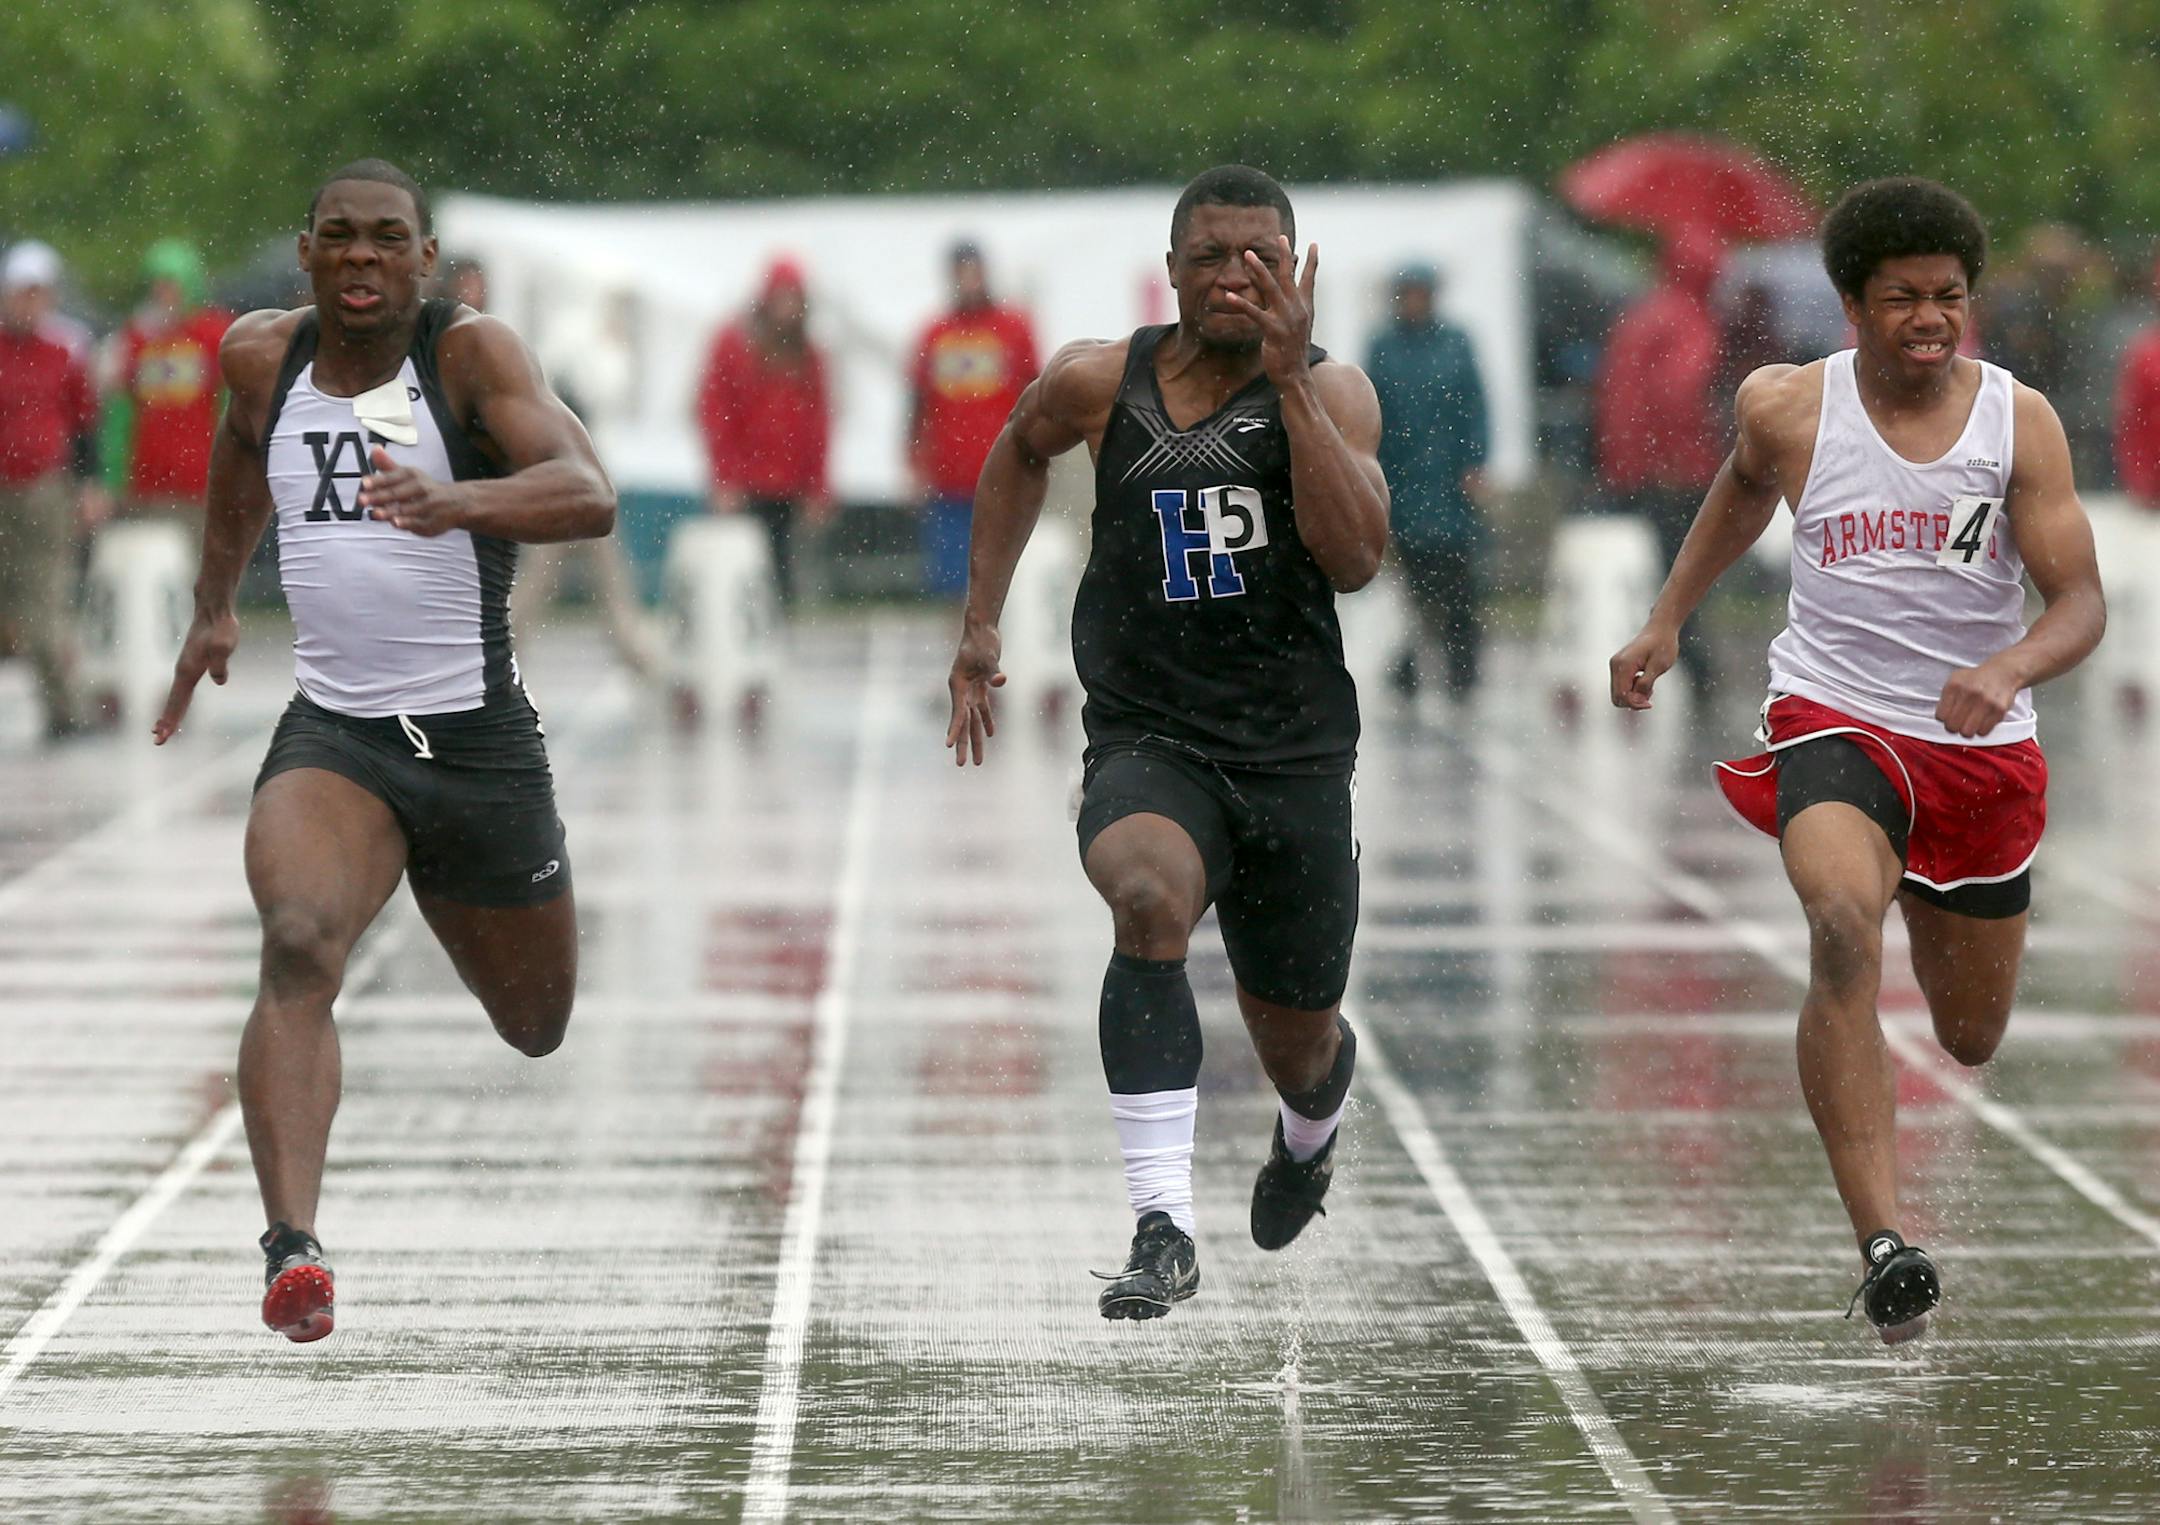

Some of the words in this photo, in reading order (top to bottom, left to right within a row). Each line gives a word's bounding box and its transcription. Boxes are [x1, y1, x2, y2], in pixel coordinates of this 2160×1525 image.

[1151, 489, 1247, 602] H
[1218, 488, 1255, 549] 5
[1950, 502, 1992, 564] 4
